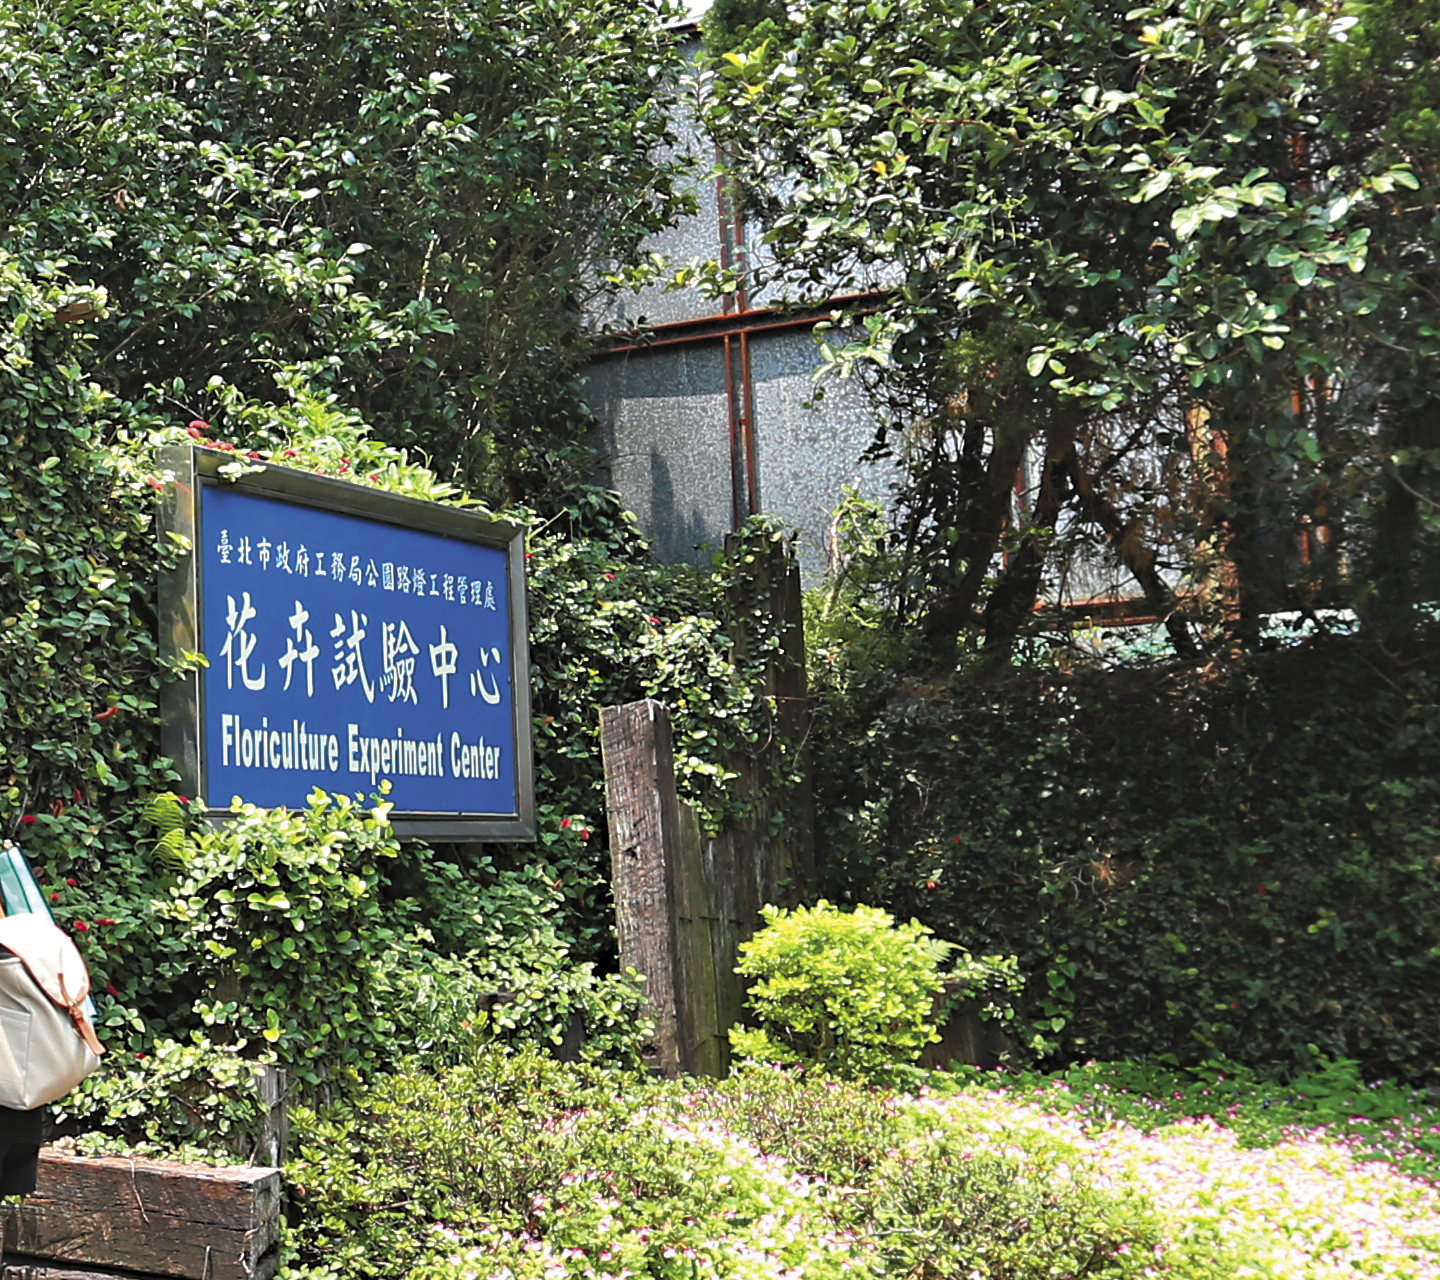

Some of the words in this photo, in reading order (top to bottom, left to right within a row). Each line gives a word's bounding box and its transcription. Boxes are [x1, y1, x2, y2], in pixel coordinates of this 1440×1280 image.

[219, 591, 502, 710] 花卉試驗中心
[221, 713, 339, 772] Floriculture
[347, 723, 444, 786] Experiment
[450, 730, 501, 780] Center
